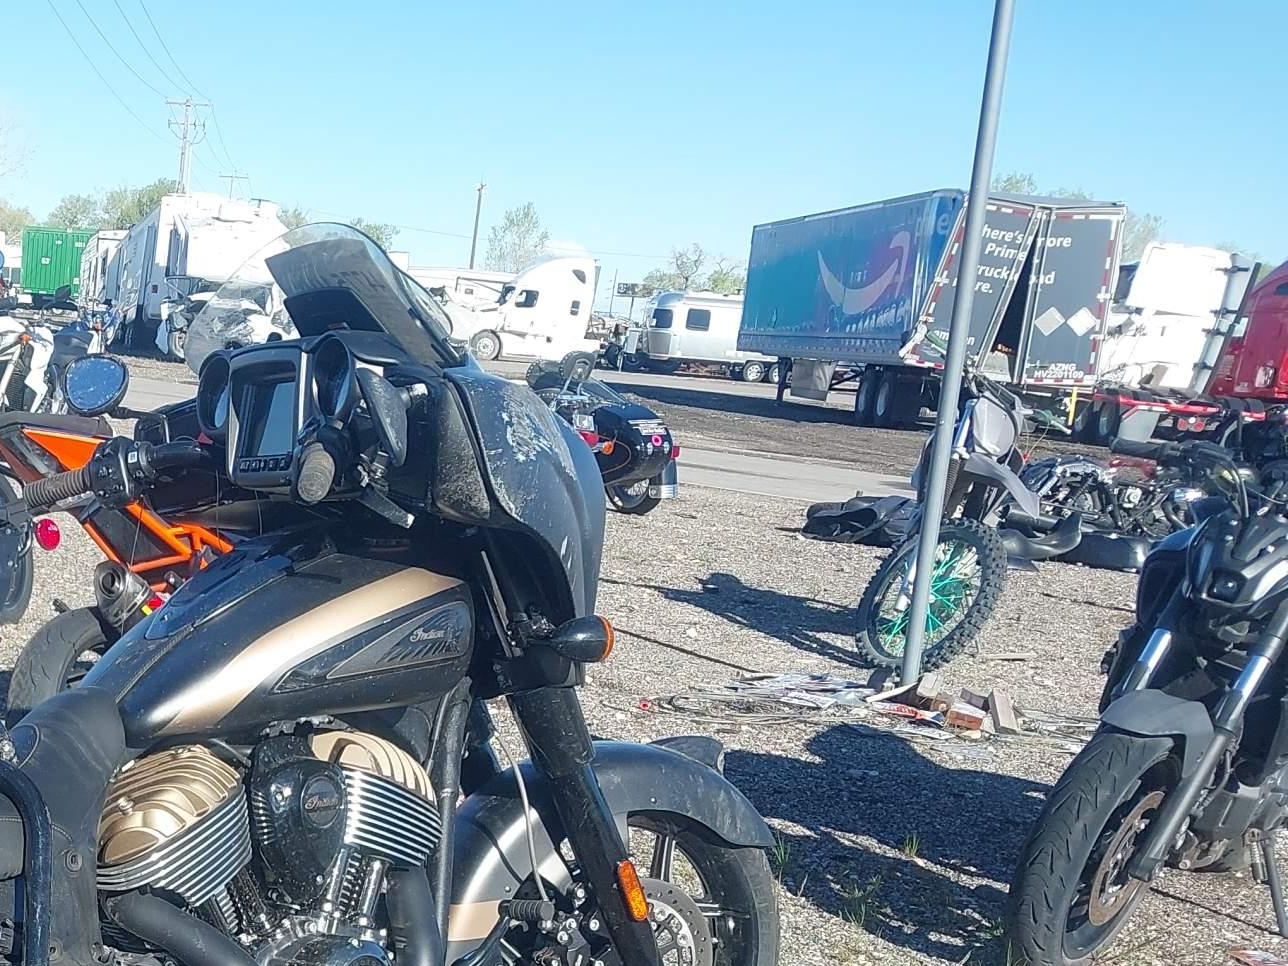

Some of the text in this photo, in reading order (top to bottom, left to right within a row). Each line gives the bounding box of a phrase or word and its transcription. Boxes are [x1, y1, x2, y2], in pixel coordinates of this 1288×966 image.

[981, 223, 1025, 245] here's
[410, 627, 445, 642] Indian
[304, 795, 340, 810] Indian
